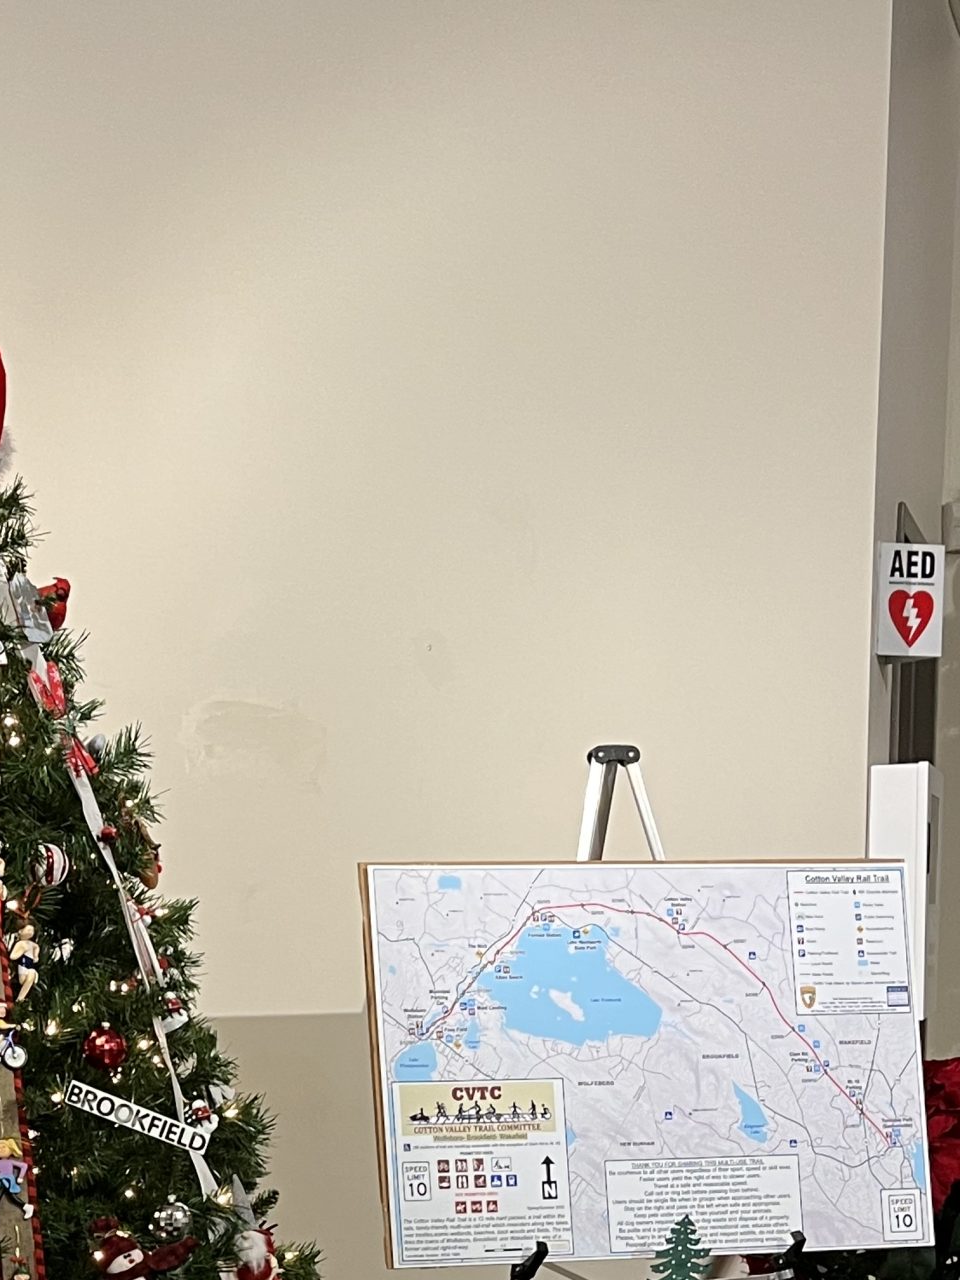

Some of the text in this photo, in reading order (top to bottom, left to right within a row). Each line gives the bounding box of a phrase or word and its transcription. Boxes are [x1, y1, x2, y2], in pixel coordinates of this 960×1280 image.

[889, 550, 936, 579] AED
[833, 874, 854, 884] Valley
[874, 874, 890, 882] Trail
[451, 1086, 502, 1101] CVTC
[67, 1083, 207, 1151] BROOKFIELD
[414, 1126, 444, 1134] COTTON
[497, 1124, 541, 1132] COMMITTEE
[409, 1182, 556, 1197] 10 N
[896, 1214, 912, 1228] 10
